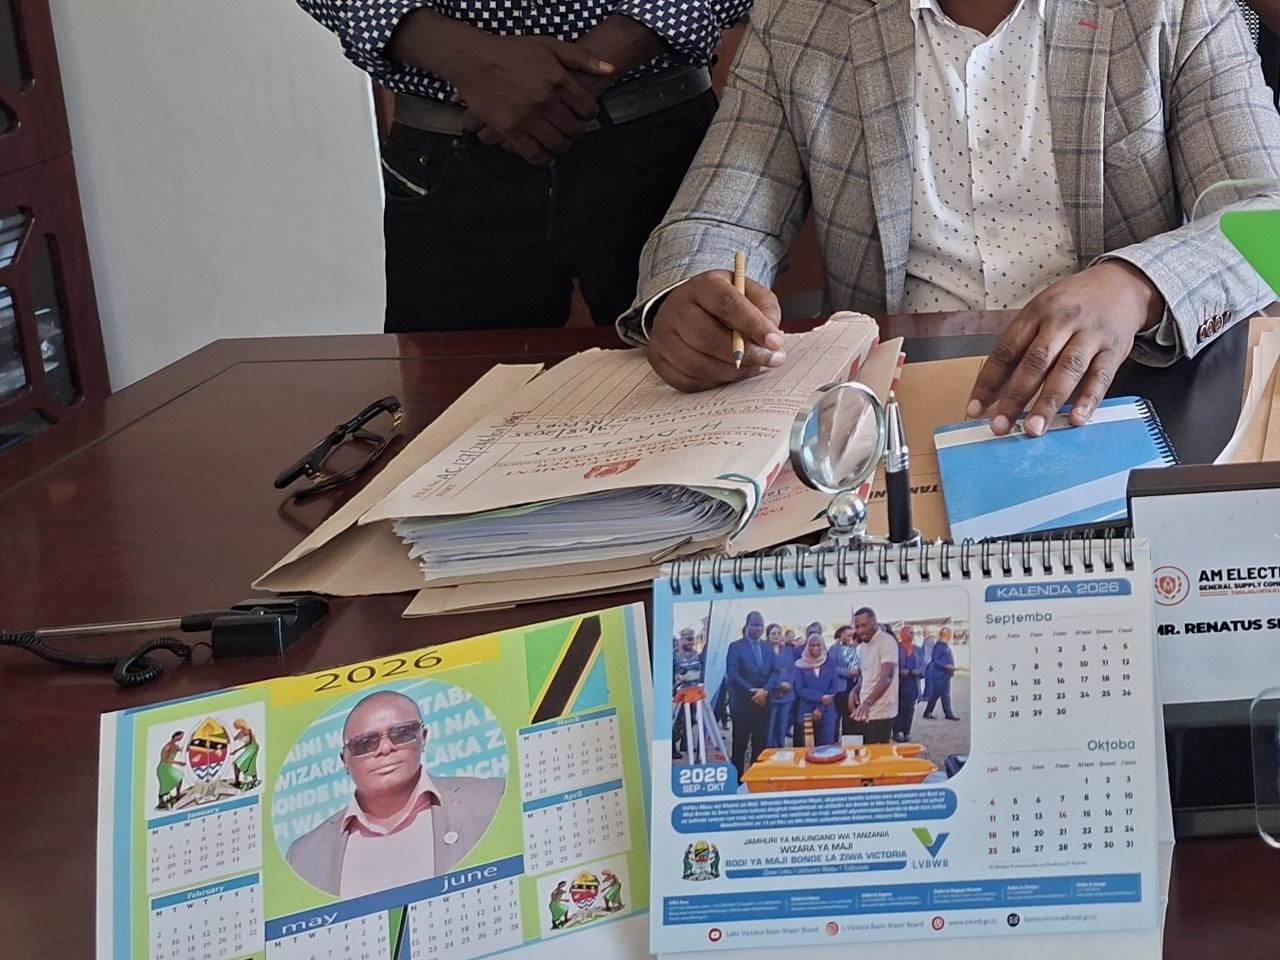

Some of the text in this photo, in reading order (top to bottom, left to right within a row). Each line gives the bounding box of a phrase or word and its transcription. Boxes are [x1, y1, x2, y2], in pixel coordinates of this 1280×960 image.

[1199, 569, 1222, 582] AM
[997, 582, 1120, 598] KALENDA 2026
[1199, 583, 1233, 591] GENERAL
[985, 612, 1052, 625] Septemba
[1185, 618, 1263, 634] RENATUS
[313, 651, 443, 693] 2026
[557, 715, 581, 726] March
[1088, 739, 1135, 752] Oktoba
[679, 767, 728, 784] 2026
[682, 784, 700, 793] SEP
[708, 783, 726, 792] OKT
[563, 790, 583, 801] April
[187, 806, 220, 820] January
[744, 830, 890, 846] JAMHURI YA MUUNGANO WA TANZANIA
[780, 841, 853, 854] WIZARA YA MAJI
[726, 849, 907, 868] BODI YA MAJI BONDE LA ZIWA VICTORIA
[912, 859, 950, 869] LVBWB
[441, 866, 498, 892] june
[186, 885, 224, 900] February
[281, 911, 338, 935] may
